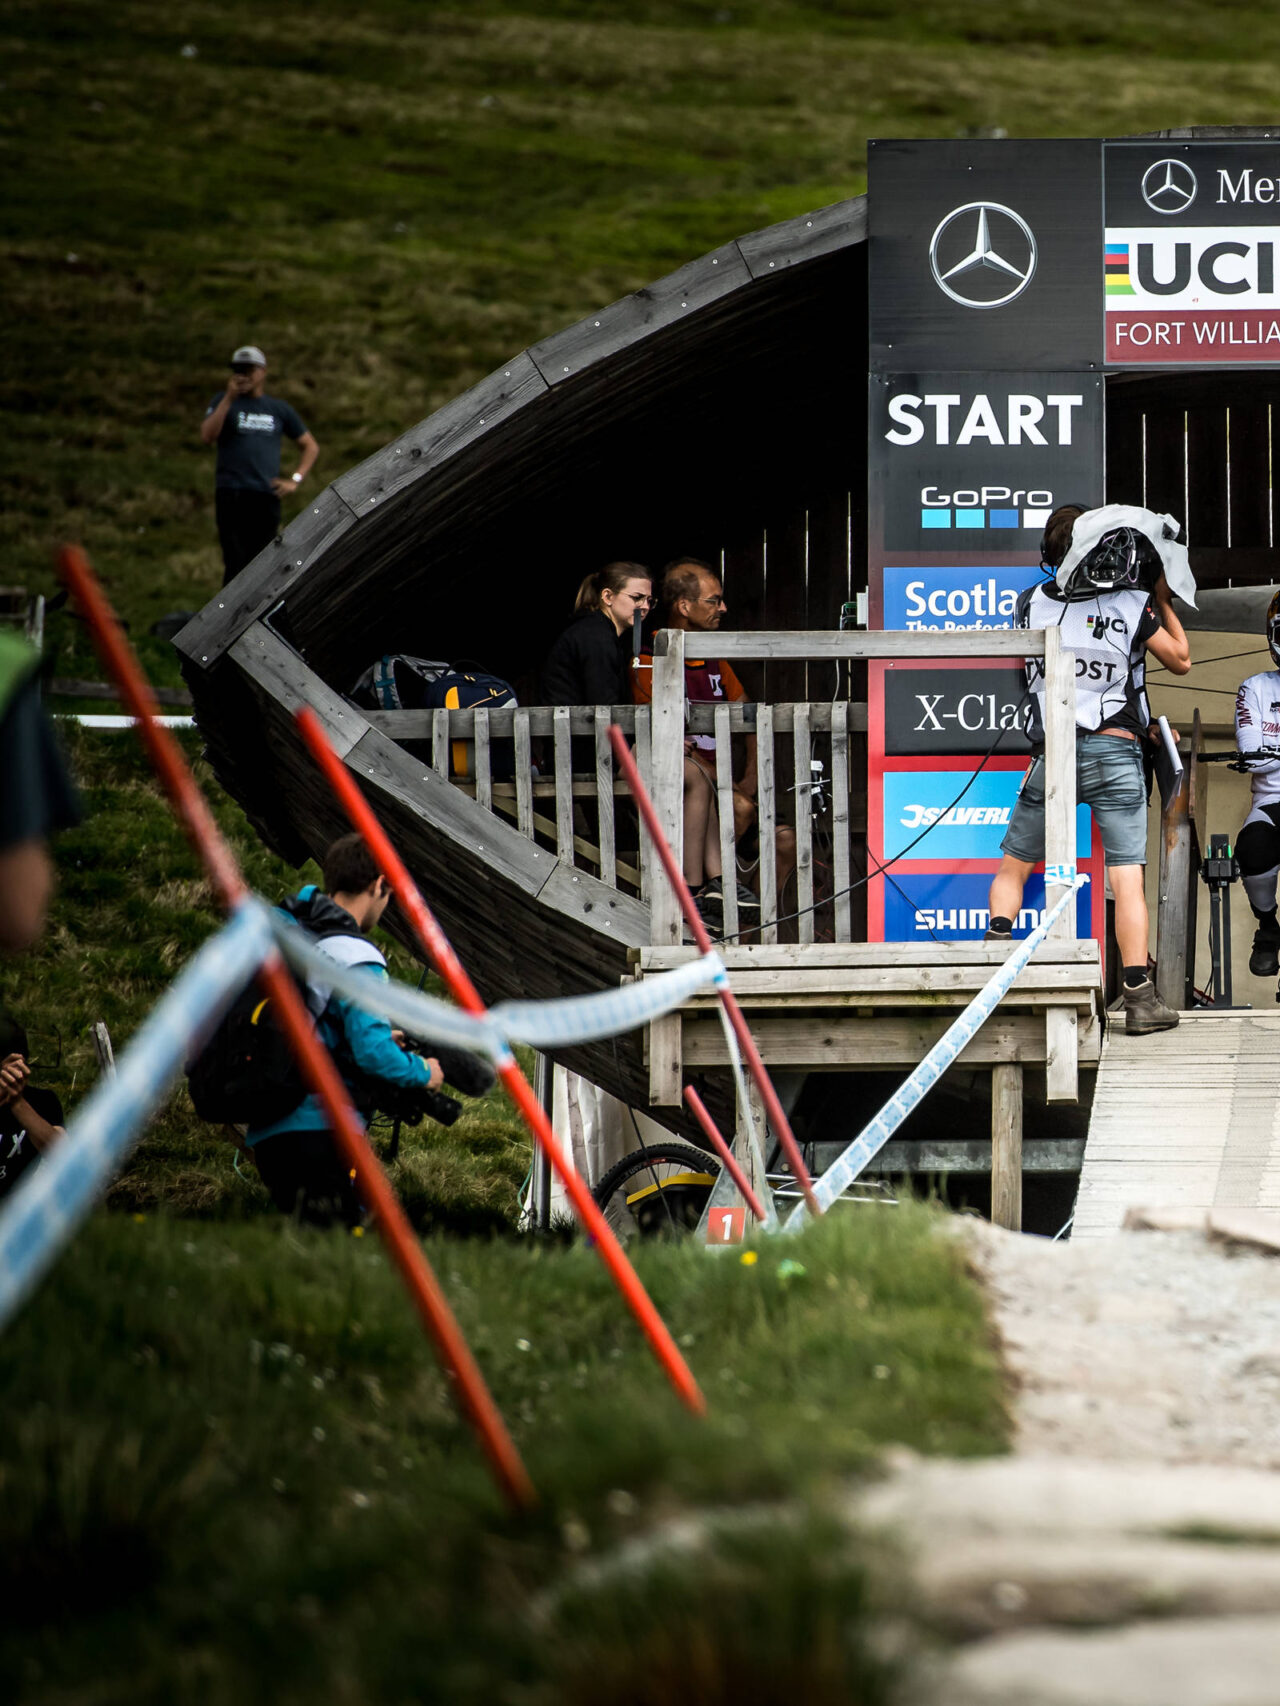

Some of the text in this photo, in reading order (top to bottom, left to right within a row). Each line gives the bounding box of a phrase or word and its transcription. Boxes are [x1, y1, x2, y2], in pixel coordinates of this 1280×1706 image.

[1136, 241, 1275, 296] UCI
[1115, 322, 1185, 345] FORT
[885, 394, 1083, 446] START
[921, 486, 1053, 506] GoPro
[905, 578, 1024, 616] Scotla
[1075, 658, 1117, 682] OST
[913, 694, 1033, 731] X-Cla
[920, 807, 1011, 825] SILVERL
[721, 1213, 733, 1241] 1
